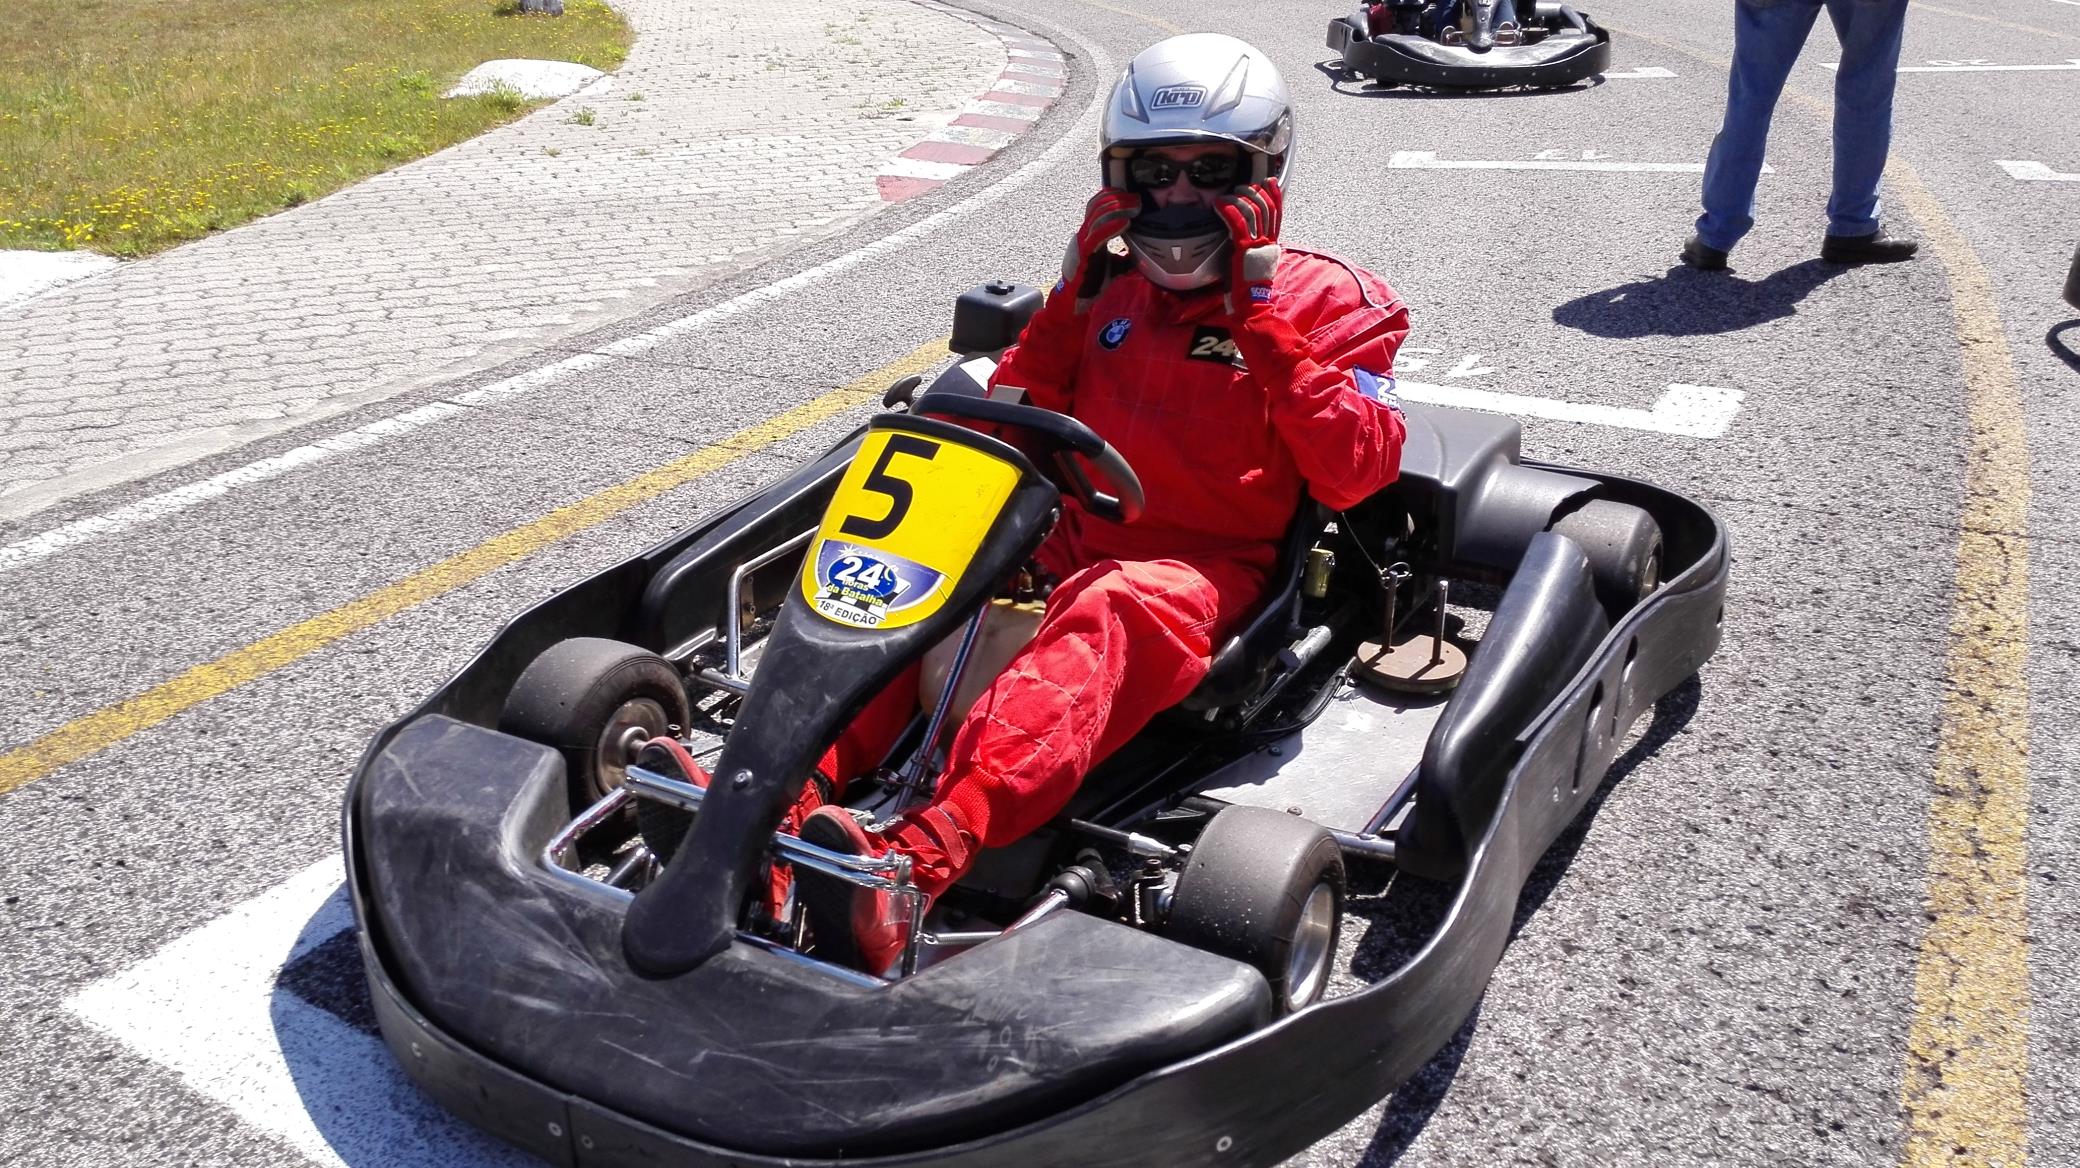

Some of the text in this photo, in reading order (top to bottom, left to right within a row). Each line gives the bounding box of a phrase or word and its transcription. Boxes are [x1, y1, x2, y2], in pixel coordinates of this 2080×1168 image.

[1191, 336, 1234, 357] 24
[839, 434, 942, 540] 5
[834, 556, 884, 589] 24
[826, 583, 884, 607] da Batalha
[835, 608, 877, 625] EDIÇÃO
